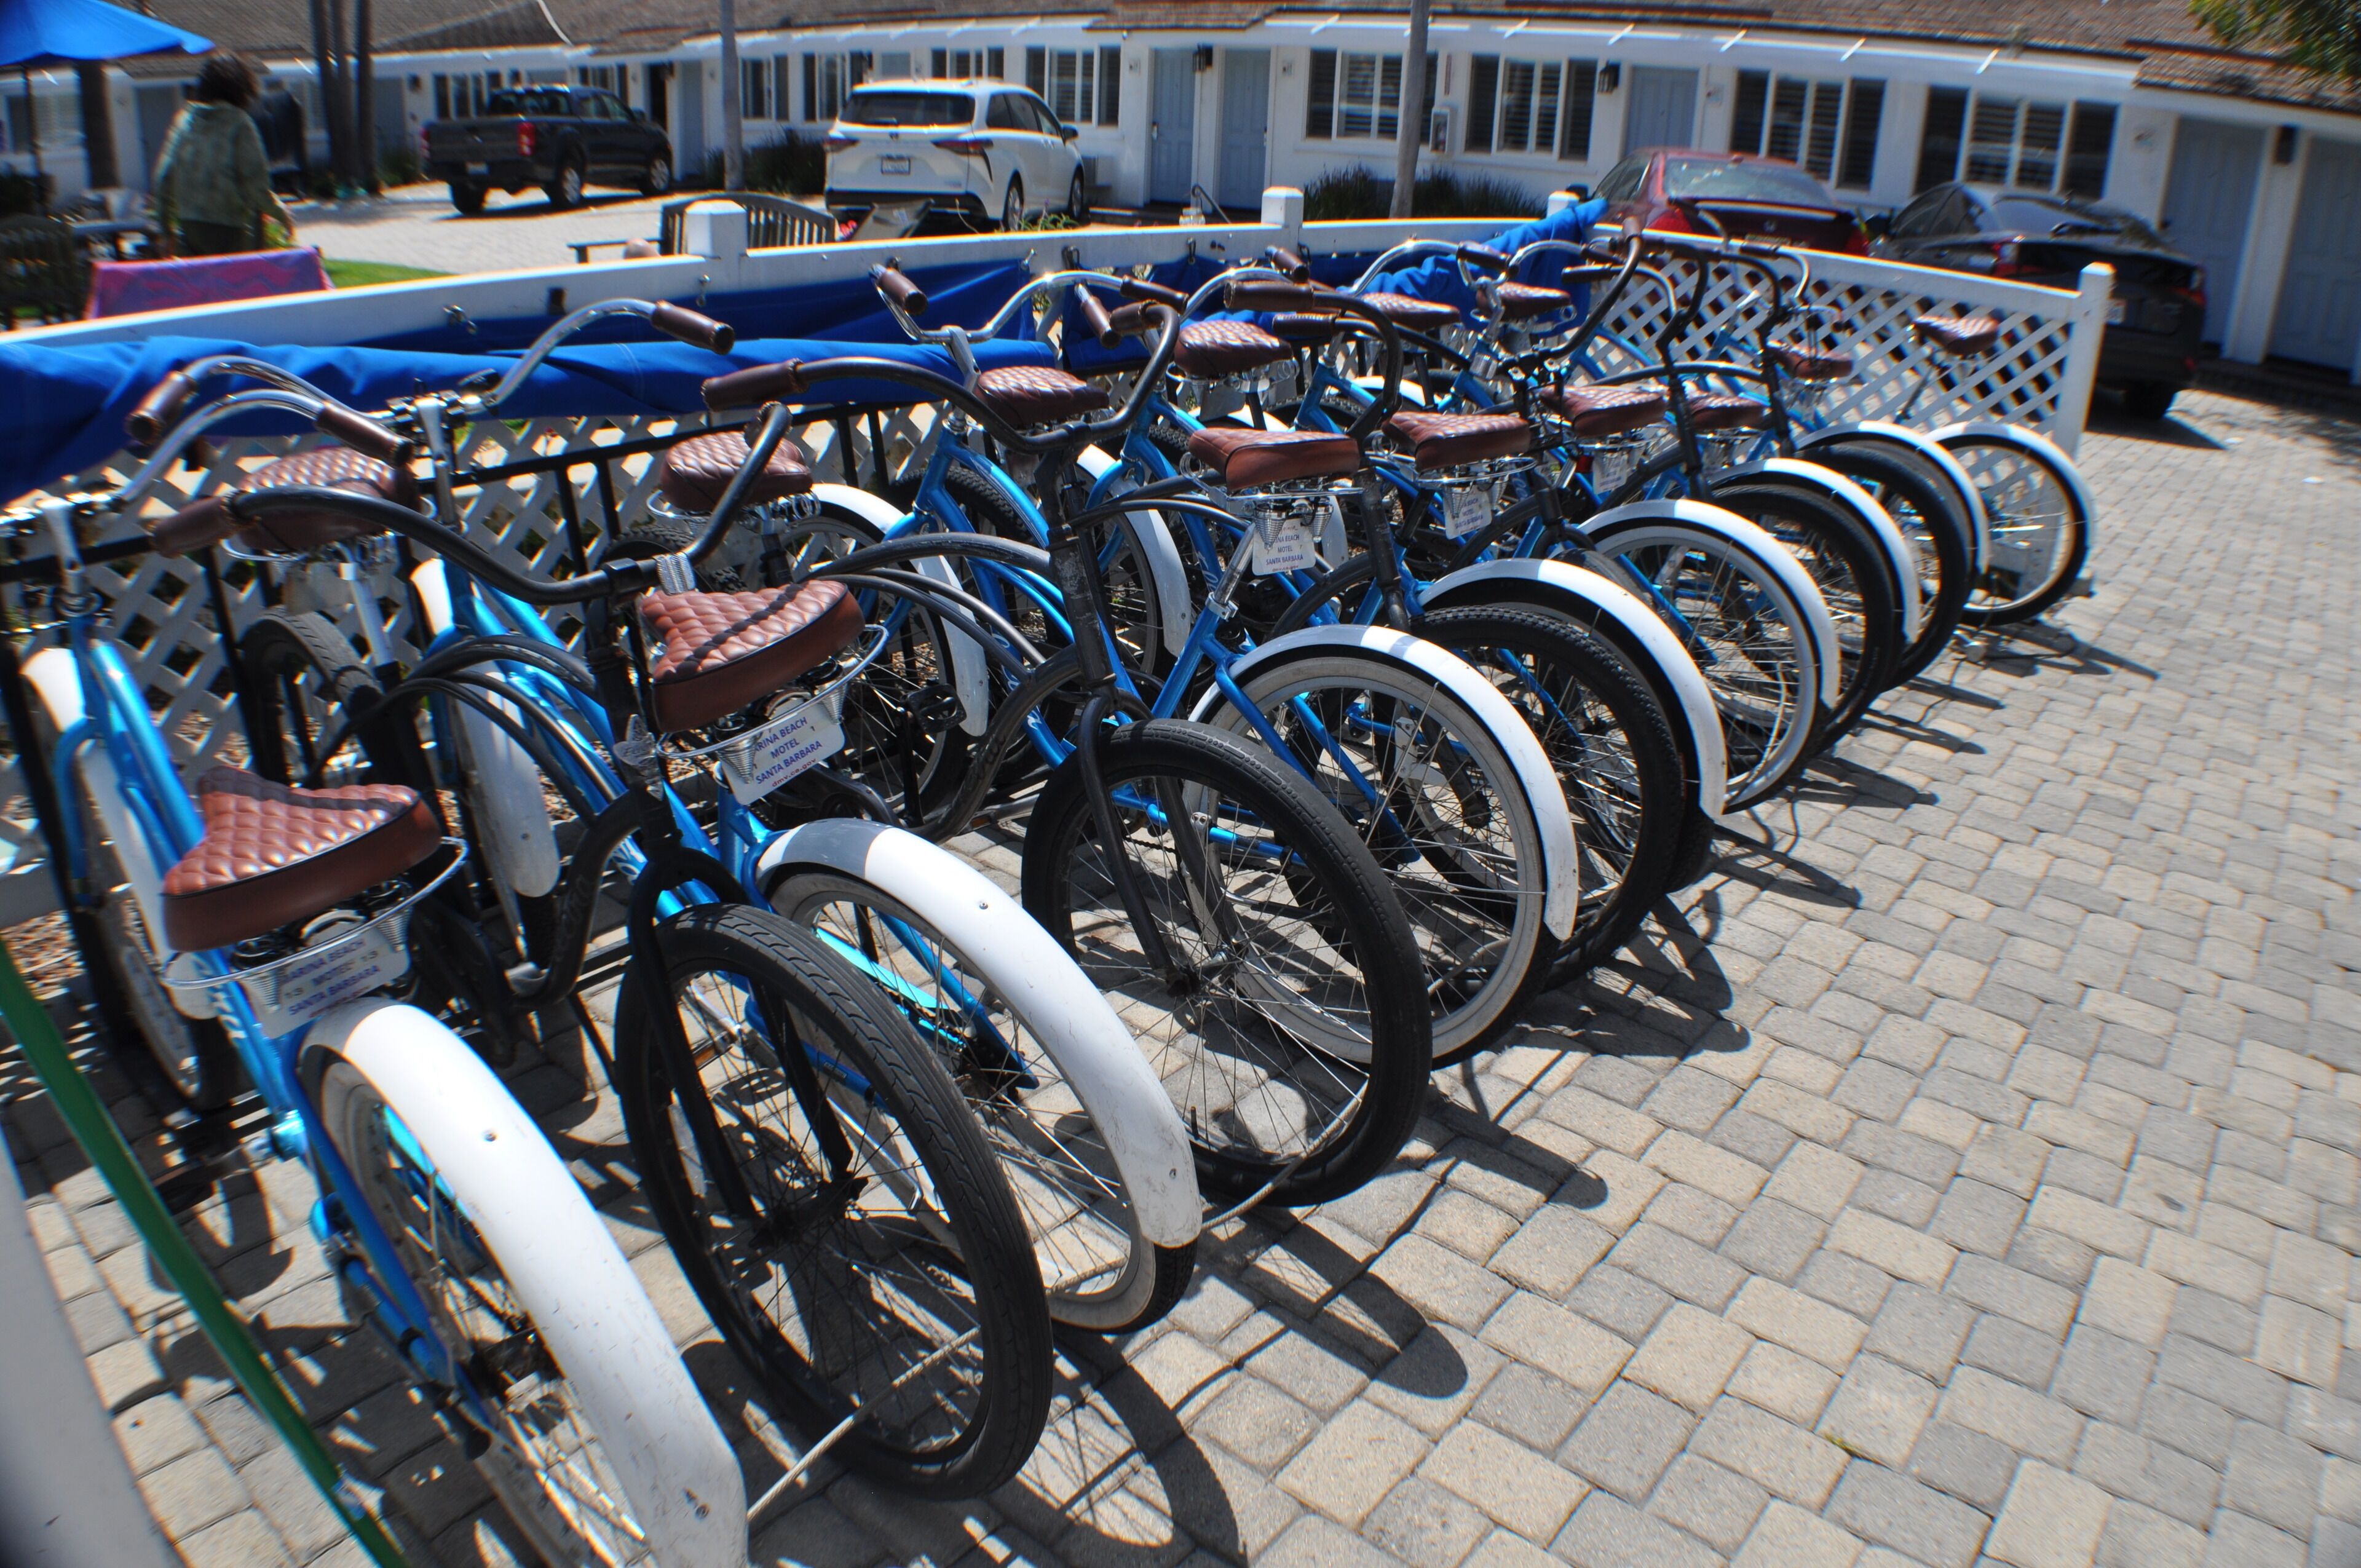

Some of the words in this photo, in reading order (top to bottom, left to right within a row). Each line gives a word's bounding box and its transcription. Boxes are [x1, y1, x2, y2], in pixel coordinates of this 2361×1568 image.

[1282, 554, 1303, 563] BARBARA
[755, 733, 780, 752] RINA
[780, 717, 807, 737] BEACH
[770, 738, 800, 759] MOTEL
[756, 764, 784, 784] SANTA
[783, 740, 823, 768] BARBARA
[772, 758, 817, 787] dmv.ca.gov
